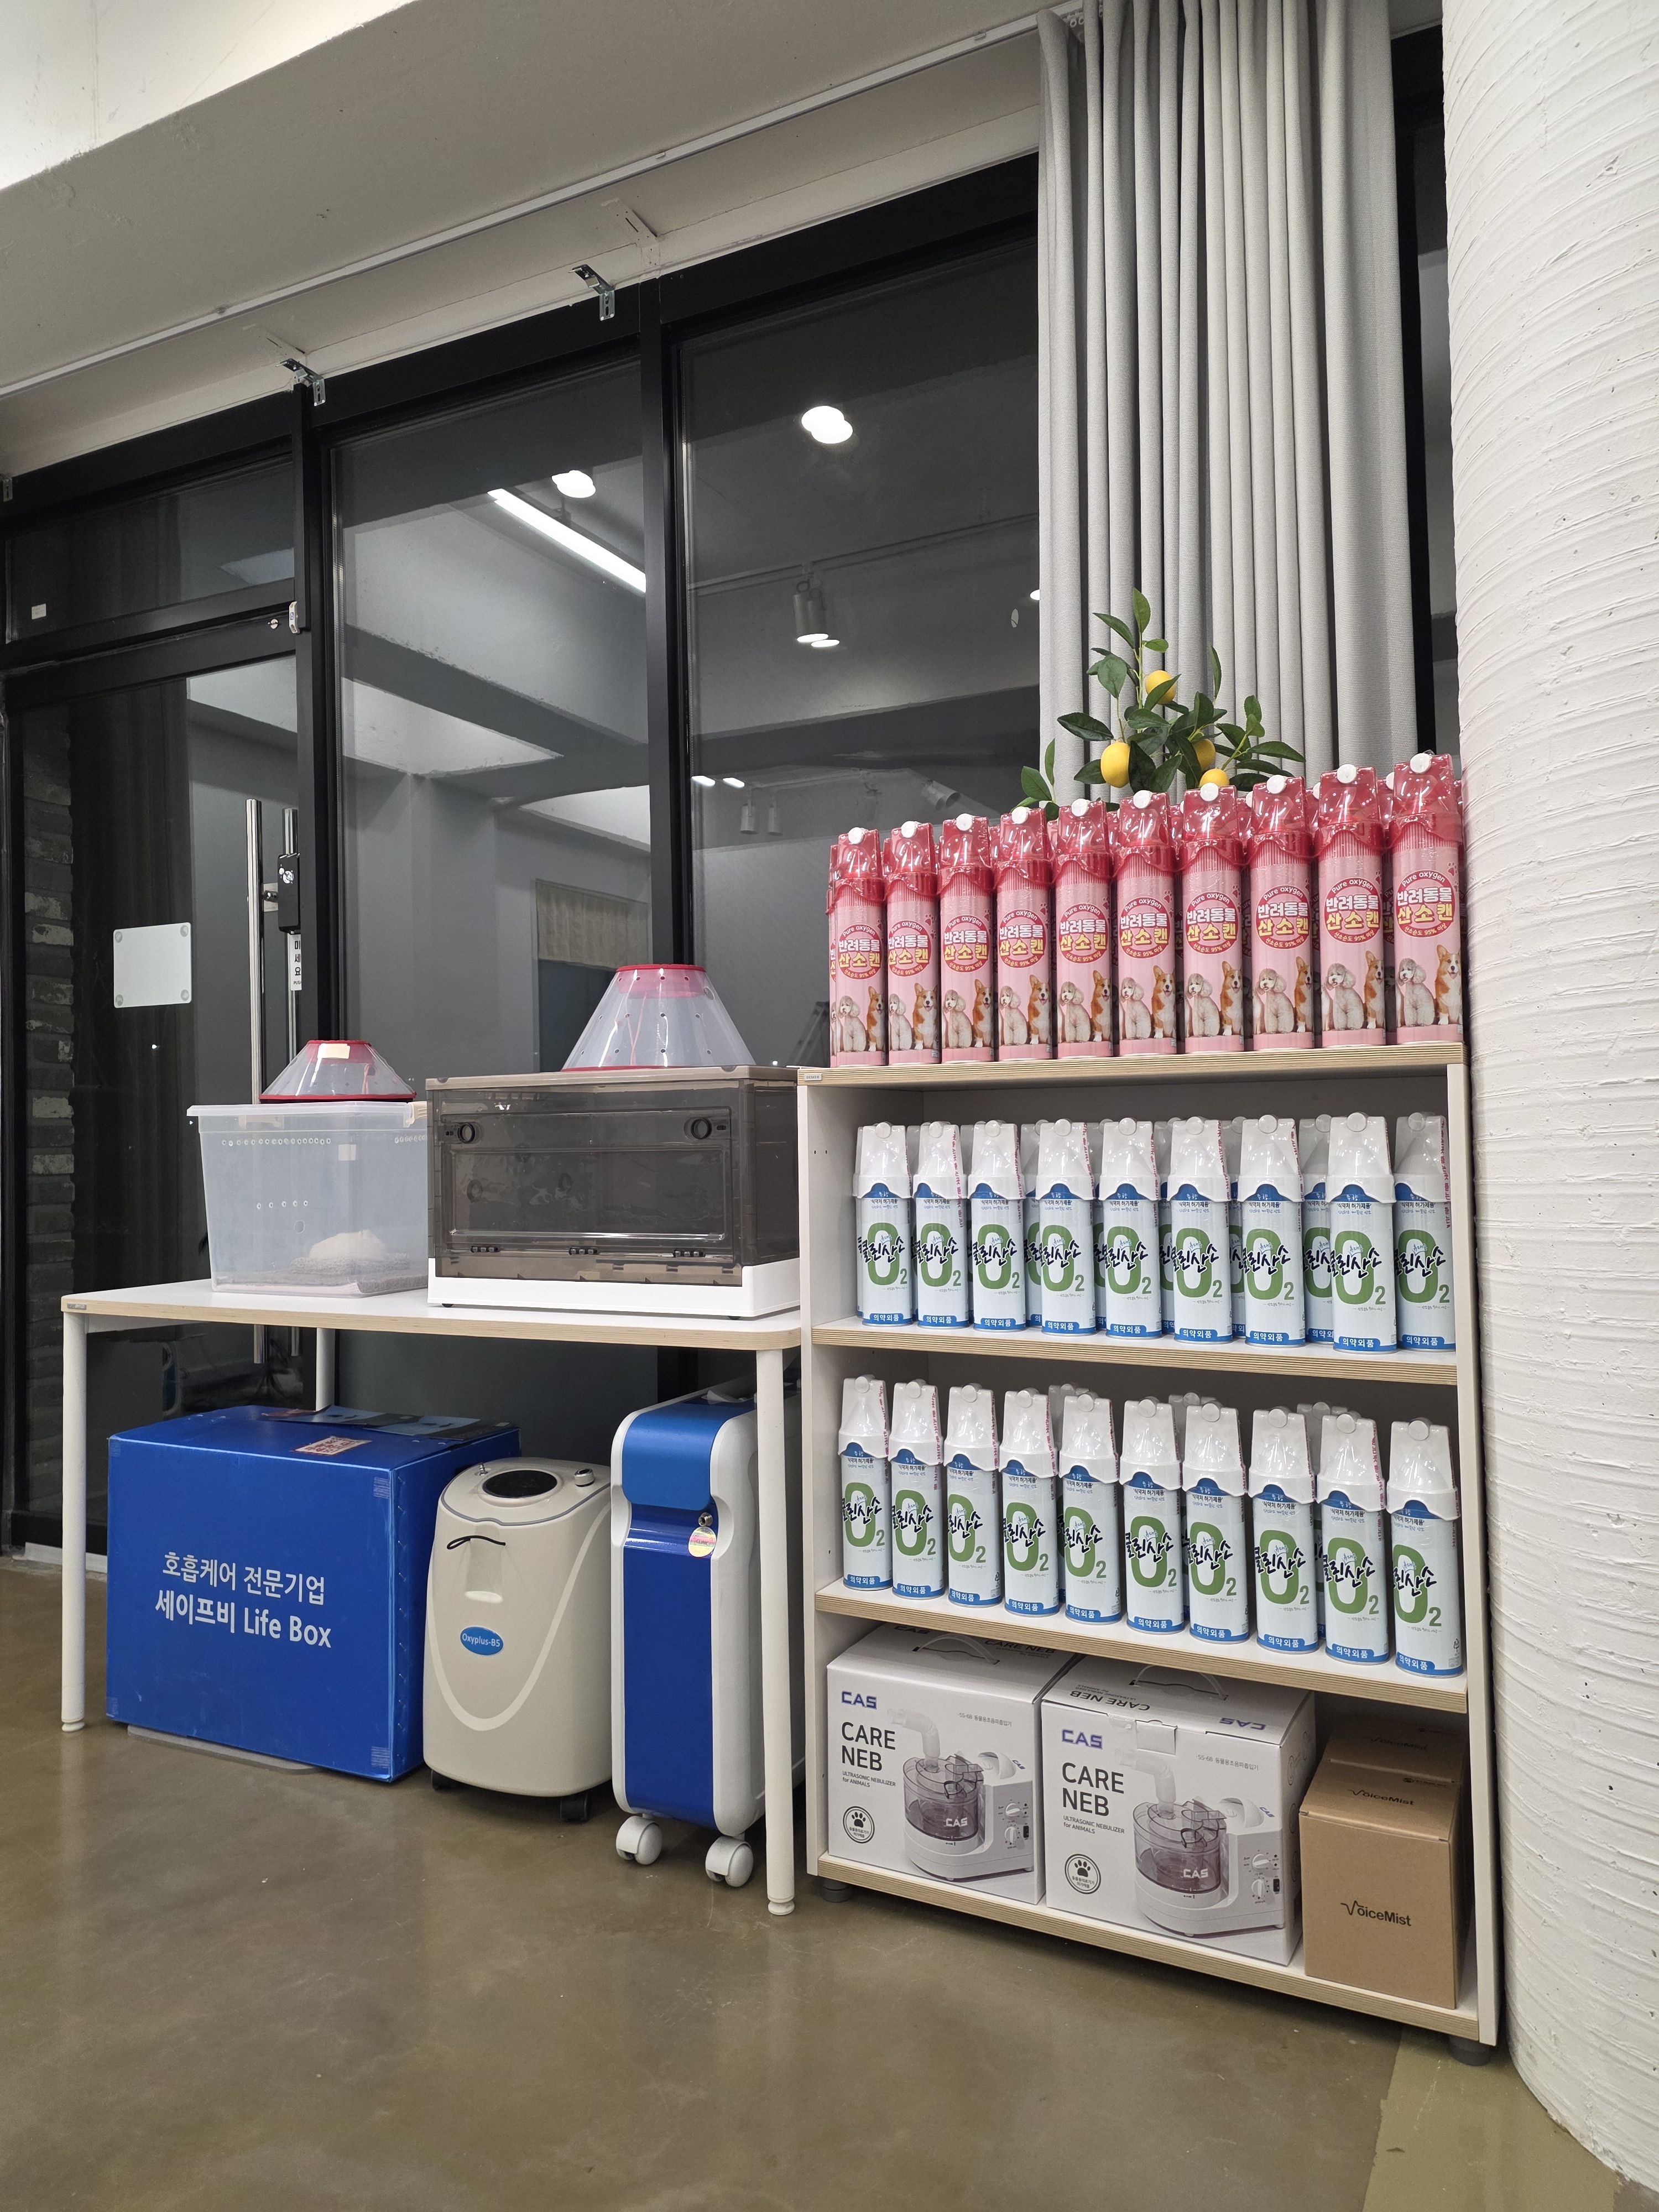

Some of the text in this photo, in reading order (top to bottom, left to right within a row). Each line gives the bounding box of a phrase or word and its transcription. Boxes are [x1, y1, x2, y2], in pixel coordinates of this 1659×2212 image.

[1332, 879, 1373, 893] Pure oxygen
[1402, 872, 1445, 886] Pure oxygen
[1192, 893, 1230, 906] Pure oxygen
[1263, 886, 1303, 900] Pure oxygen
[1397, 887, 1452, 906] 반려동물
[1124, 899, 1162, 912] Pure oxygen
[1326, 894, 1378, 912] 반려동물
[1003, 911, 1037, 924] Pure oxygen
[1065, 905, 1100, 917] Pure oxygen
[1187, 907, 1235, 924] 반려동물
[1258, 902, 1308, 919] 반려동물
[891, 922, 922, 933] Pure oxygen
[948, 917, 982, 928] Pure oxygen
[1060, 919, 1105, 935] 반려동물
[1121, 913, 1167, 929] 반려동물
[843, 926, 875, 937] Pure oxygen
[944, 930, 987, 945] 반려동물
[999, 924, 1043, 940] 반려동물
[839, 939, 880, 952] 반려동물
[888, 935, 928, 950] 반려동물
[863, 1236, 905, 1262] 클린산소
[916, 1237, 958, 1264] 클린산소
[973, 1239, 1017, 1266] 클린산소
[1331, 1248, 1382, 1278] 클린산소
[1394, 1246, 1446, 1277] 클린산소
[1048, 1322, 1074, 1331] 의약외품
[1113, 1325, 1141, 1334] 의약외품
[1183, 1329, 1212, 1338] 의약외품
[1253, 1332, 1283, 1342] 의약외품
[1343, 1338, 1374, 1348] 의약외품
[1406, 1335, 1439, 1345] 의약외품
[891, 1505, 933, 1532] 클린산소
[1125, 1532, 1173, 1563] 클린산소
[1255, 1547, 1306, 1578] 클린산소
[1323, 1554, 1375, 1588] 클린산소
[163, 1552, 325, 1606] 호흡케어 전문기업
[850, 1576, 875, 1584] 의약외품
[900, 1585, 926, 1594] 의약외품
[951, 1590, 974, 1601] 의약외품
[1011, 1601, 1038, 1611] 의약외품
[1070, 1607, 1095, 1619] 의약외품
[155, 1590, 331, 1649] 세이프비 Life Box
[1138, 1619, 1167, 1629] 의약외품
[894, 1626, 930, 1634] CAS
[1197, 1626, 1225, 1637] 의약외품
[462, 1633, 500, 1647] Oxyplus-B5
[984, 1640, 1022, 1650] CARE
[1026, 1645, 1055, 1653] NEB
[1268, 1637, 1299, 1648] 의약외품
[1336, 1646, 1368, 1658] 의약외품
[1400, 1655, 1428, 1670] 의약외품
[841, 1691, 877, 1709] CAS
[1070, 1691, 1150, 1711] CARE NEB
[1219, 1717, 1267, 1731] CAS
[841, 1722, 896, 1750] CARE
[1061, 1729, 1103, 1750] CAS
[842, 1745, 882, 1771] NEB
[842, 1771, 896, 1786] ULTRASONIC NEBULIZER
[850, 1779, 870, 1787] ANIMALS
[1062, 1762, 1124, 1794] CARE
[1062, 1788, 1109, 1817] NEB
[1348, 1790, 1415, 1806] VoiceMist
[945, 1817, 968, 1827] CAS
[1063, 1815, 1125, 1834] ULTRASONIC NEBULIZER
[1072, 1824, 1095, 1834] ANIMALS
[1183, 1869, 1209, 1879] CAS
[1340, 1900, 1411, 1926] VoiceMist
